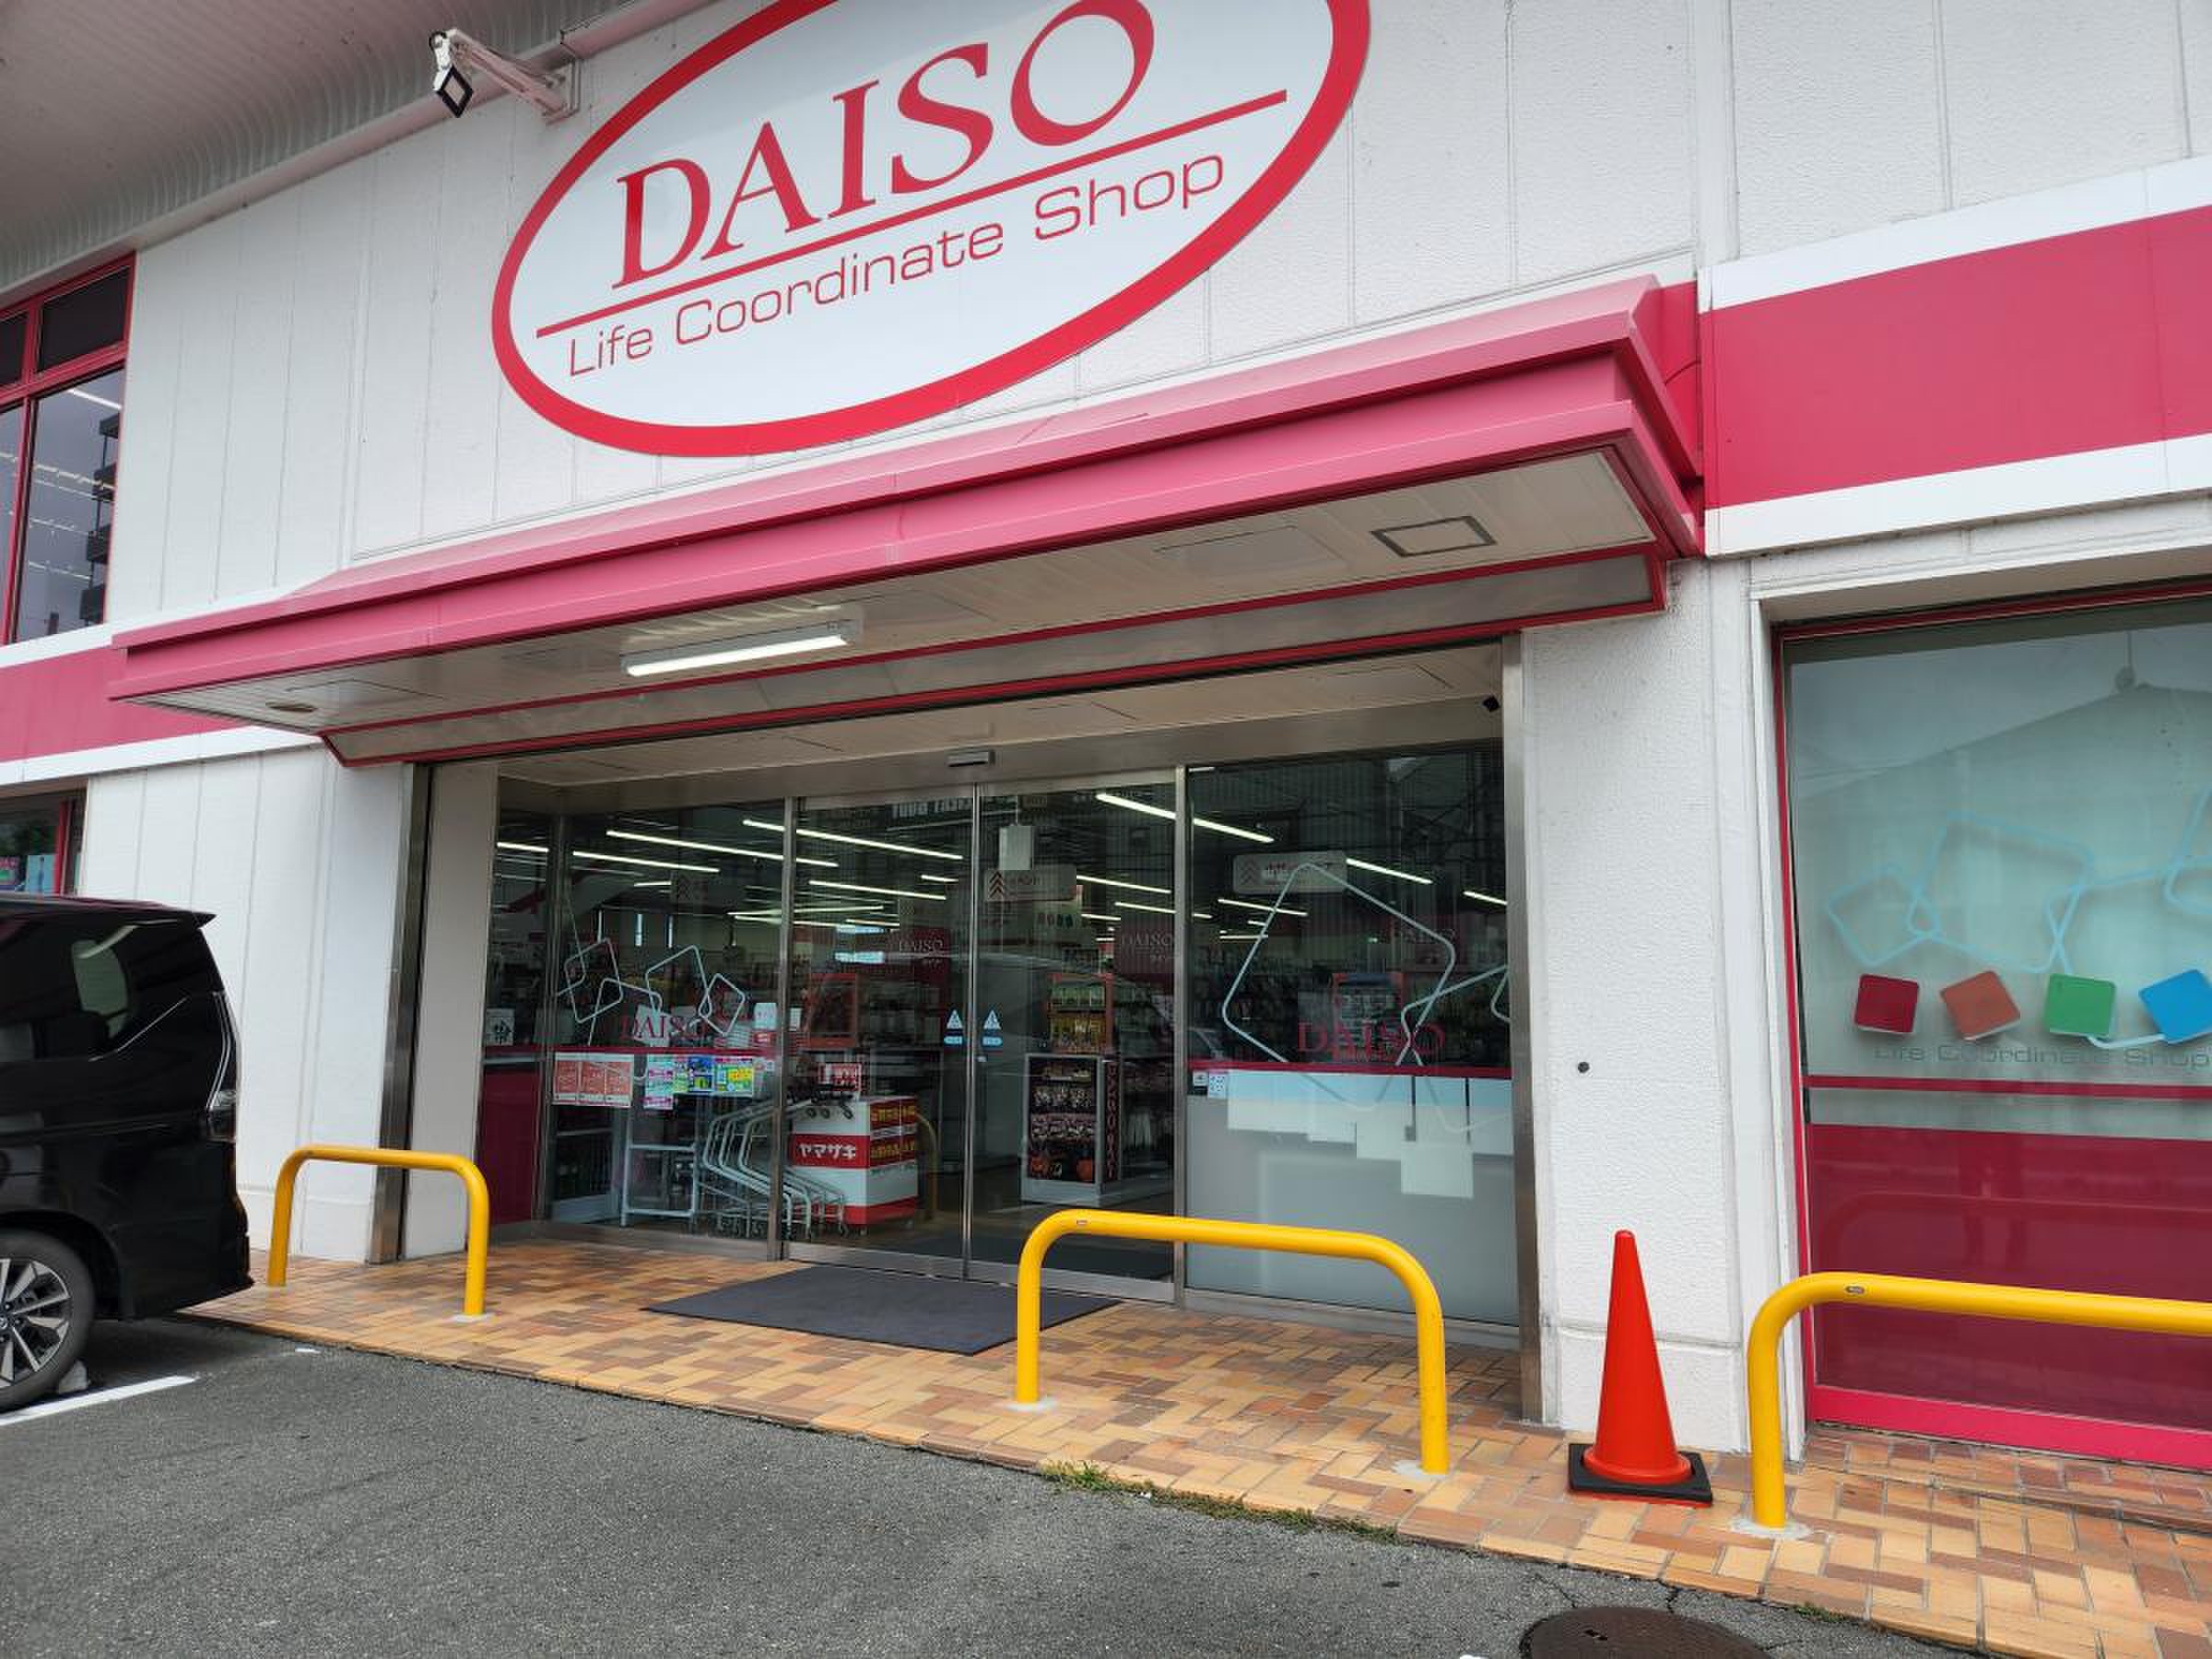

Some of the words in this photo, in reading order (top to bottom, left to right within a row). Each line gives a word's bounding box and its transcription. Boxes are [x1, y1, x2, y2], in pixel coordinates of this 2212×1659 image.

[611, 0, 1155, 290] DAISO
[569, 324, 653, 377] Life
[675, 223, 1004, 347] Coordinate
[1033, 152, 1225, 241] Shop
[797, 1143, 856, 1159] ヤマザキ
